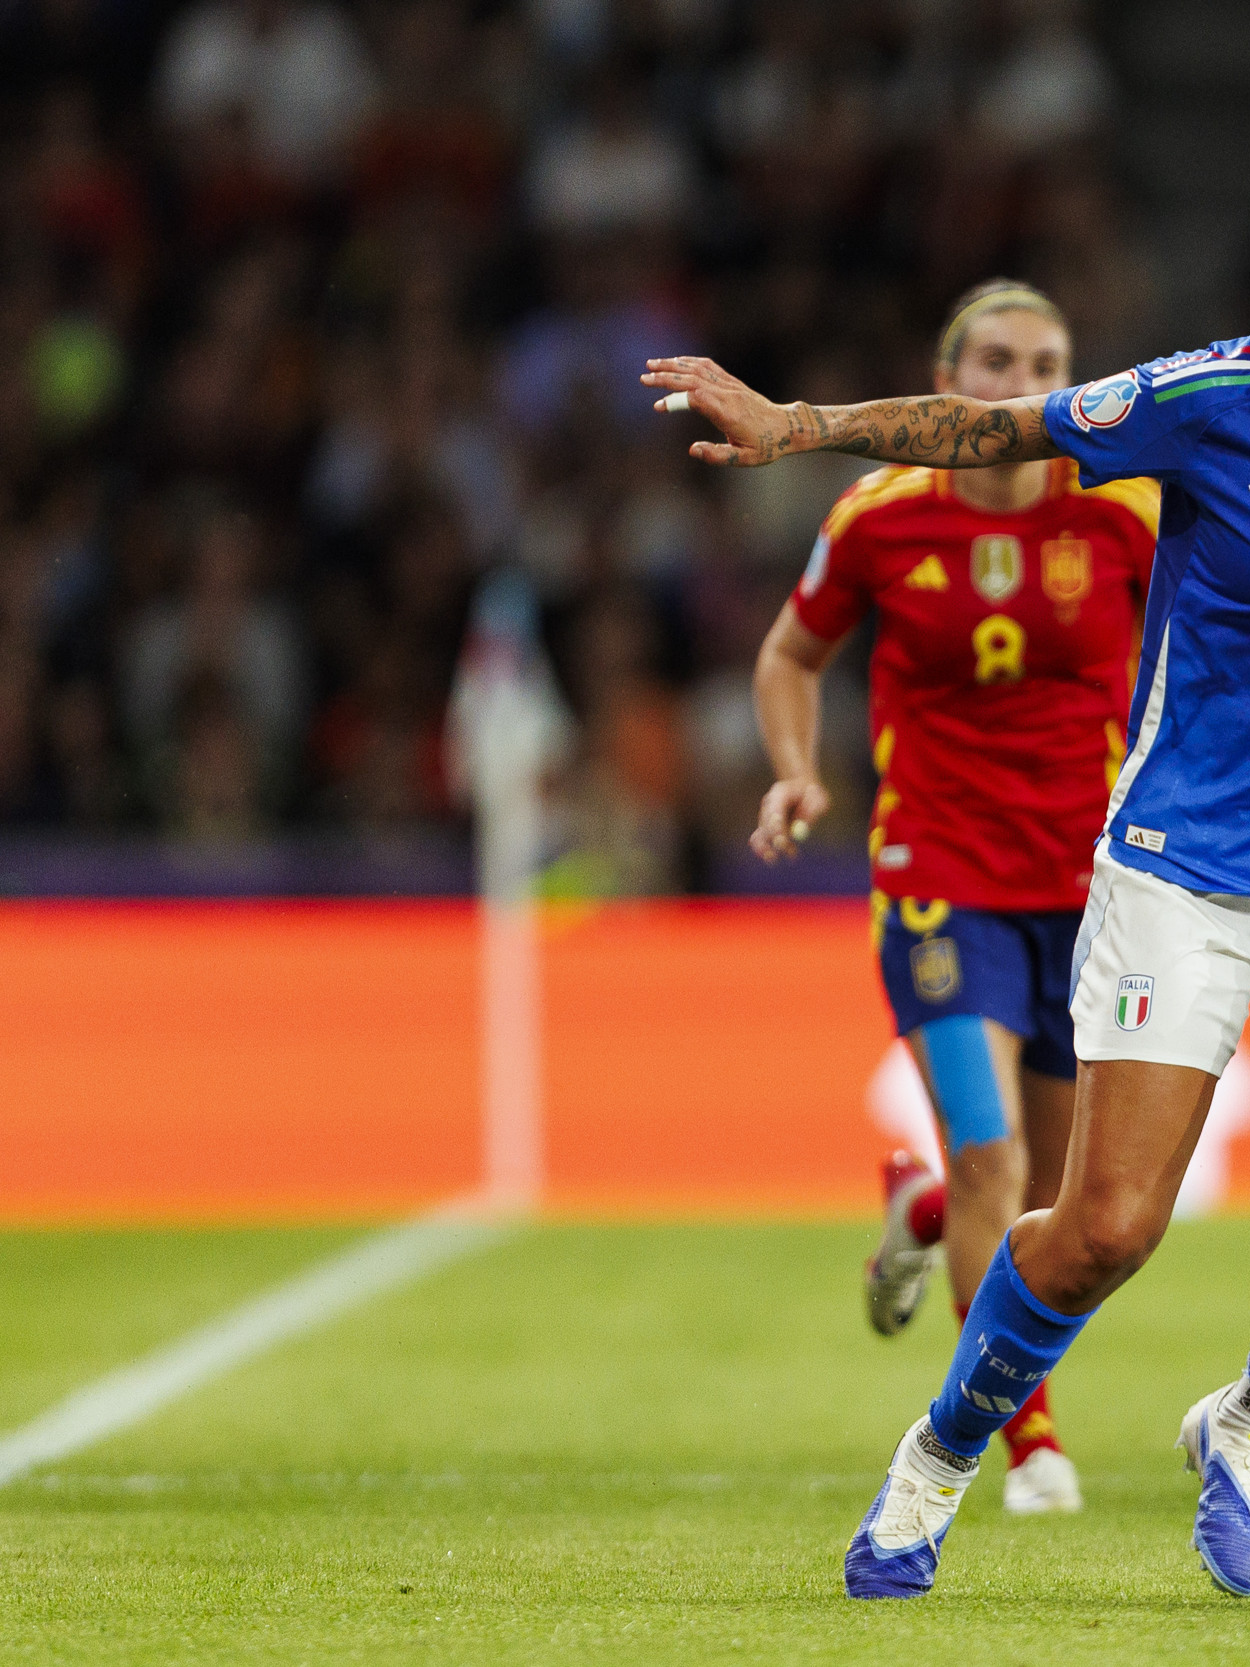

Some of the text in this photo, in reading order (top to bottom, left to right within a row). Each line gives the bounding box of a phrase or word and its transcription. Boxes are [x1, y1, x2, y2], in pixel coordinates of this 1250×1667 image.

[972, 613, 1028, 686] 8
[1120, 979, 1150, 990] ITALIA
[977, 1331, 1049, 1382] ITALIA
